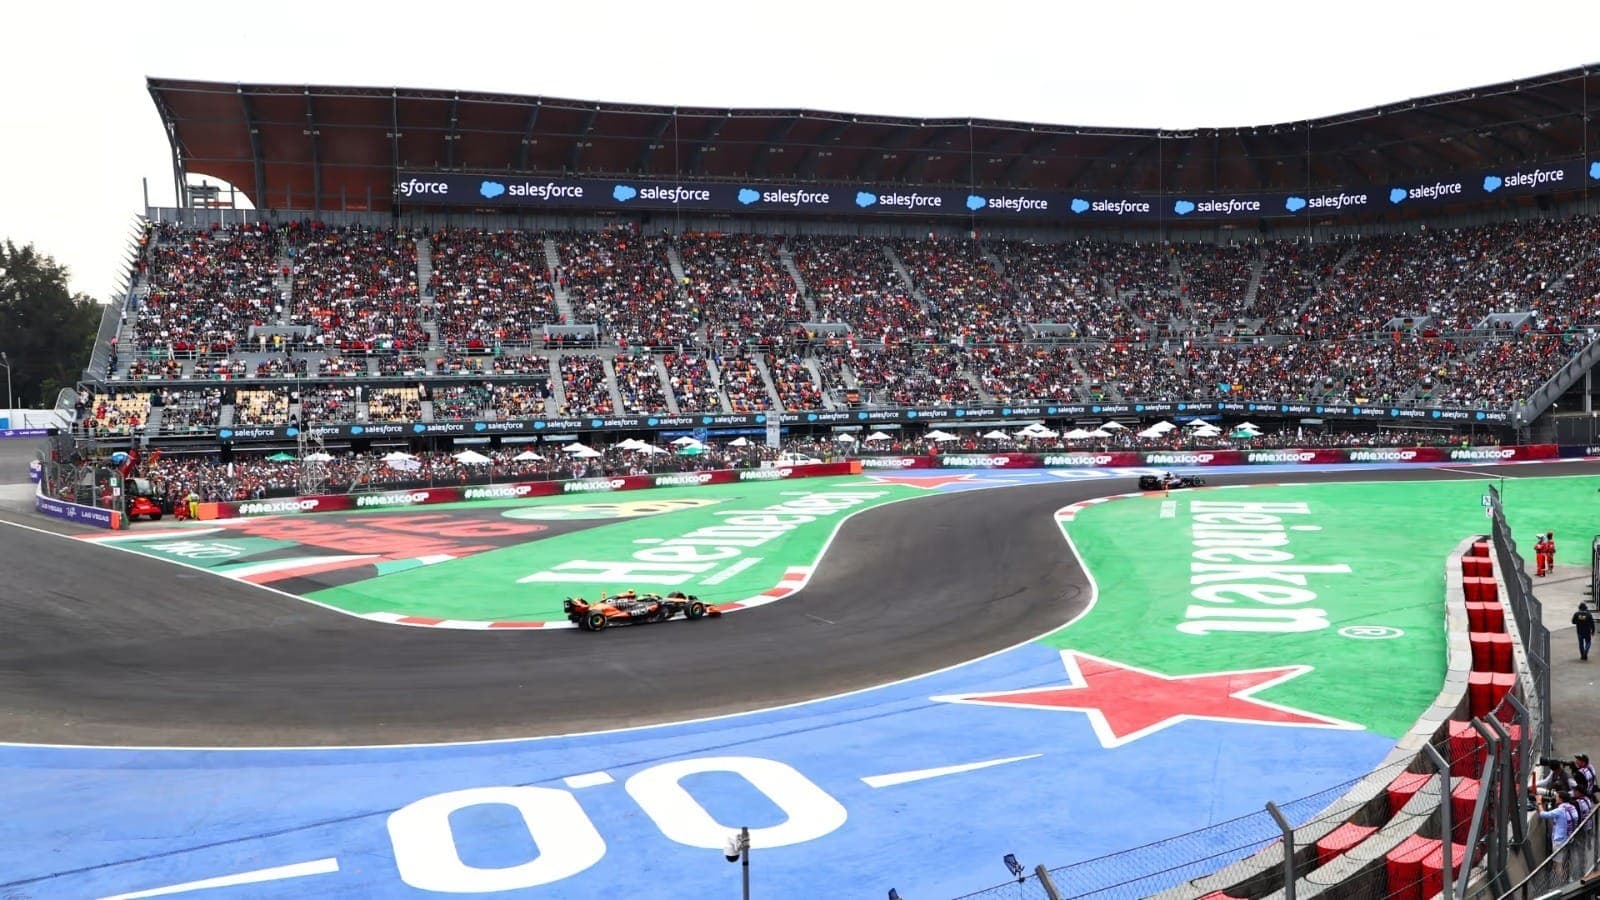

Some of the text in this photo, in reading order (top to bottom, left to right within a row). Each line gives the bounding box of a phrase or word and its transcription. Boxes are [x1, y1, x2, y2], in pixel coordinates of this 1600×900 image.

[398, 170, 1563, 214] sforce salesforce salesforce salesforce salesforce salesforce salesforce salesforce salesforce salesforce salesforce
[234, 428, 274, 438] salesforce
[365, 425, 402, 434] salesforce
[427, 424, 464, 433] salesforce
[488, 422, 523, 431] salesforce
[547, 420, 582, 429] salesforce
[604, 419, 638, 427] salesforce
[660, 417, 693, 426] salesforce
[715, 416, 746, 424] salesforce
[918, 410, 947, 418] salesforce
[1058, 406, 1085, 414] salesforce
[1102, 405, 1128, 413] salesforce
[1145, 404, 1171, 412] salesforce
[239, 500, 319, 514] #MexicoGP
[357, 493, 430, 506] #MexicoGP
[464, 485, 532, 498] #MexicoGP
[564, 479, 625, 491] #MexicoGP
[656, 473, 712, 485] #MexicoGP
[740, 468, 793, 480] #MexicoGP
[943, 457, 1010, 466] #MexicoGP
[1044, 455, 1112, 465] #MexicoGP
[1146, 453, 1214, 463] #MexicoGP
[1248, 452, 1315, 462] #MexicoGP
[1350, 451, 1416, 461] #MexicoGP
[1451, 449, 1516, 460] #MexicoGP
[515, 492, 890, 585] Heineken
[1176, 500, 1352, 635] Heineken
